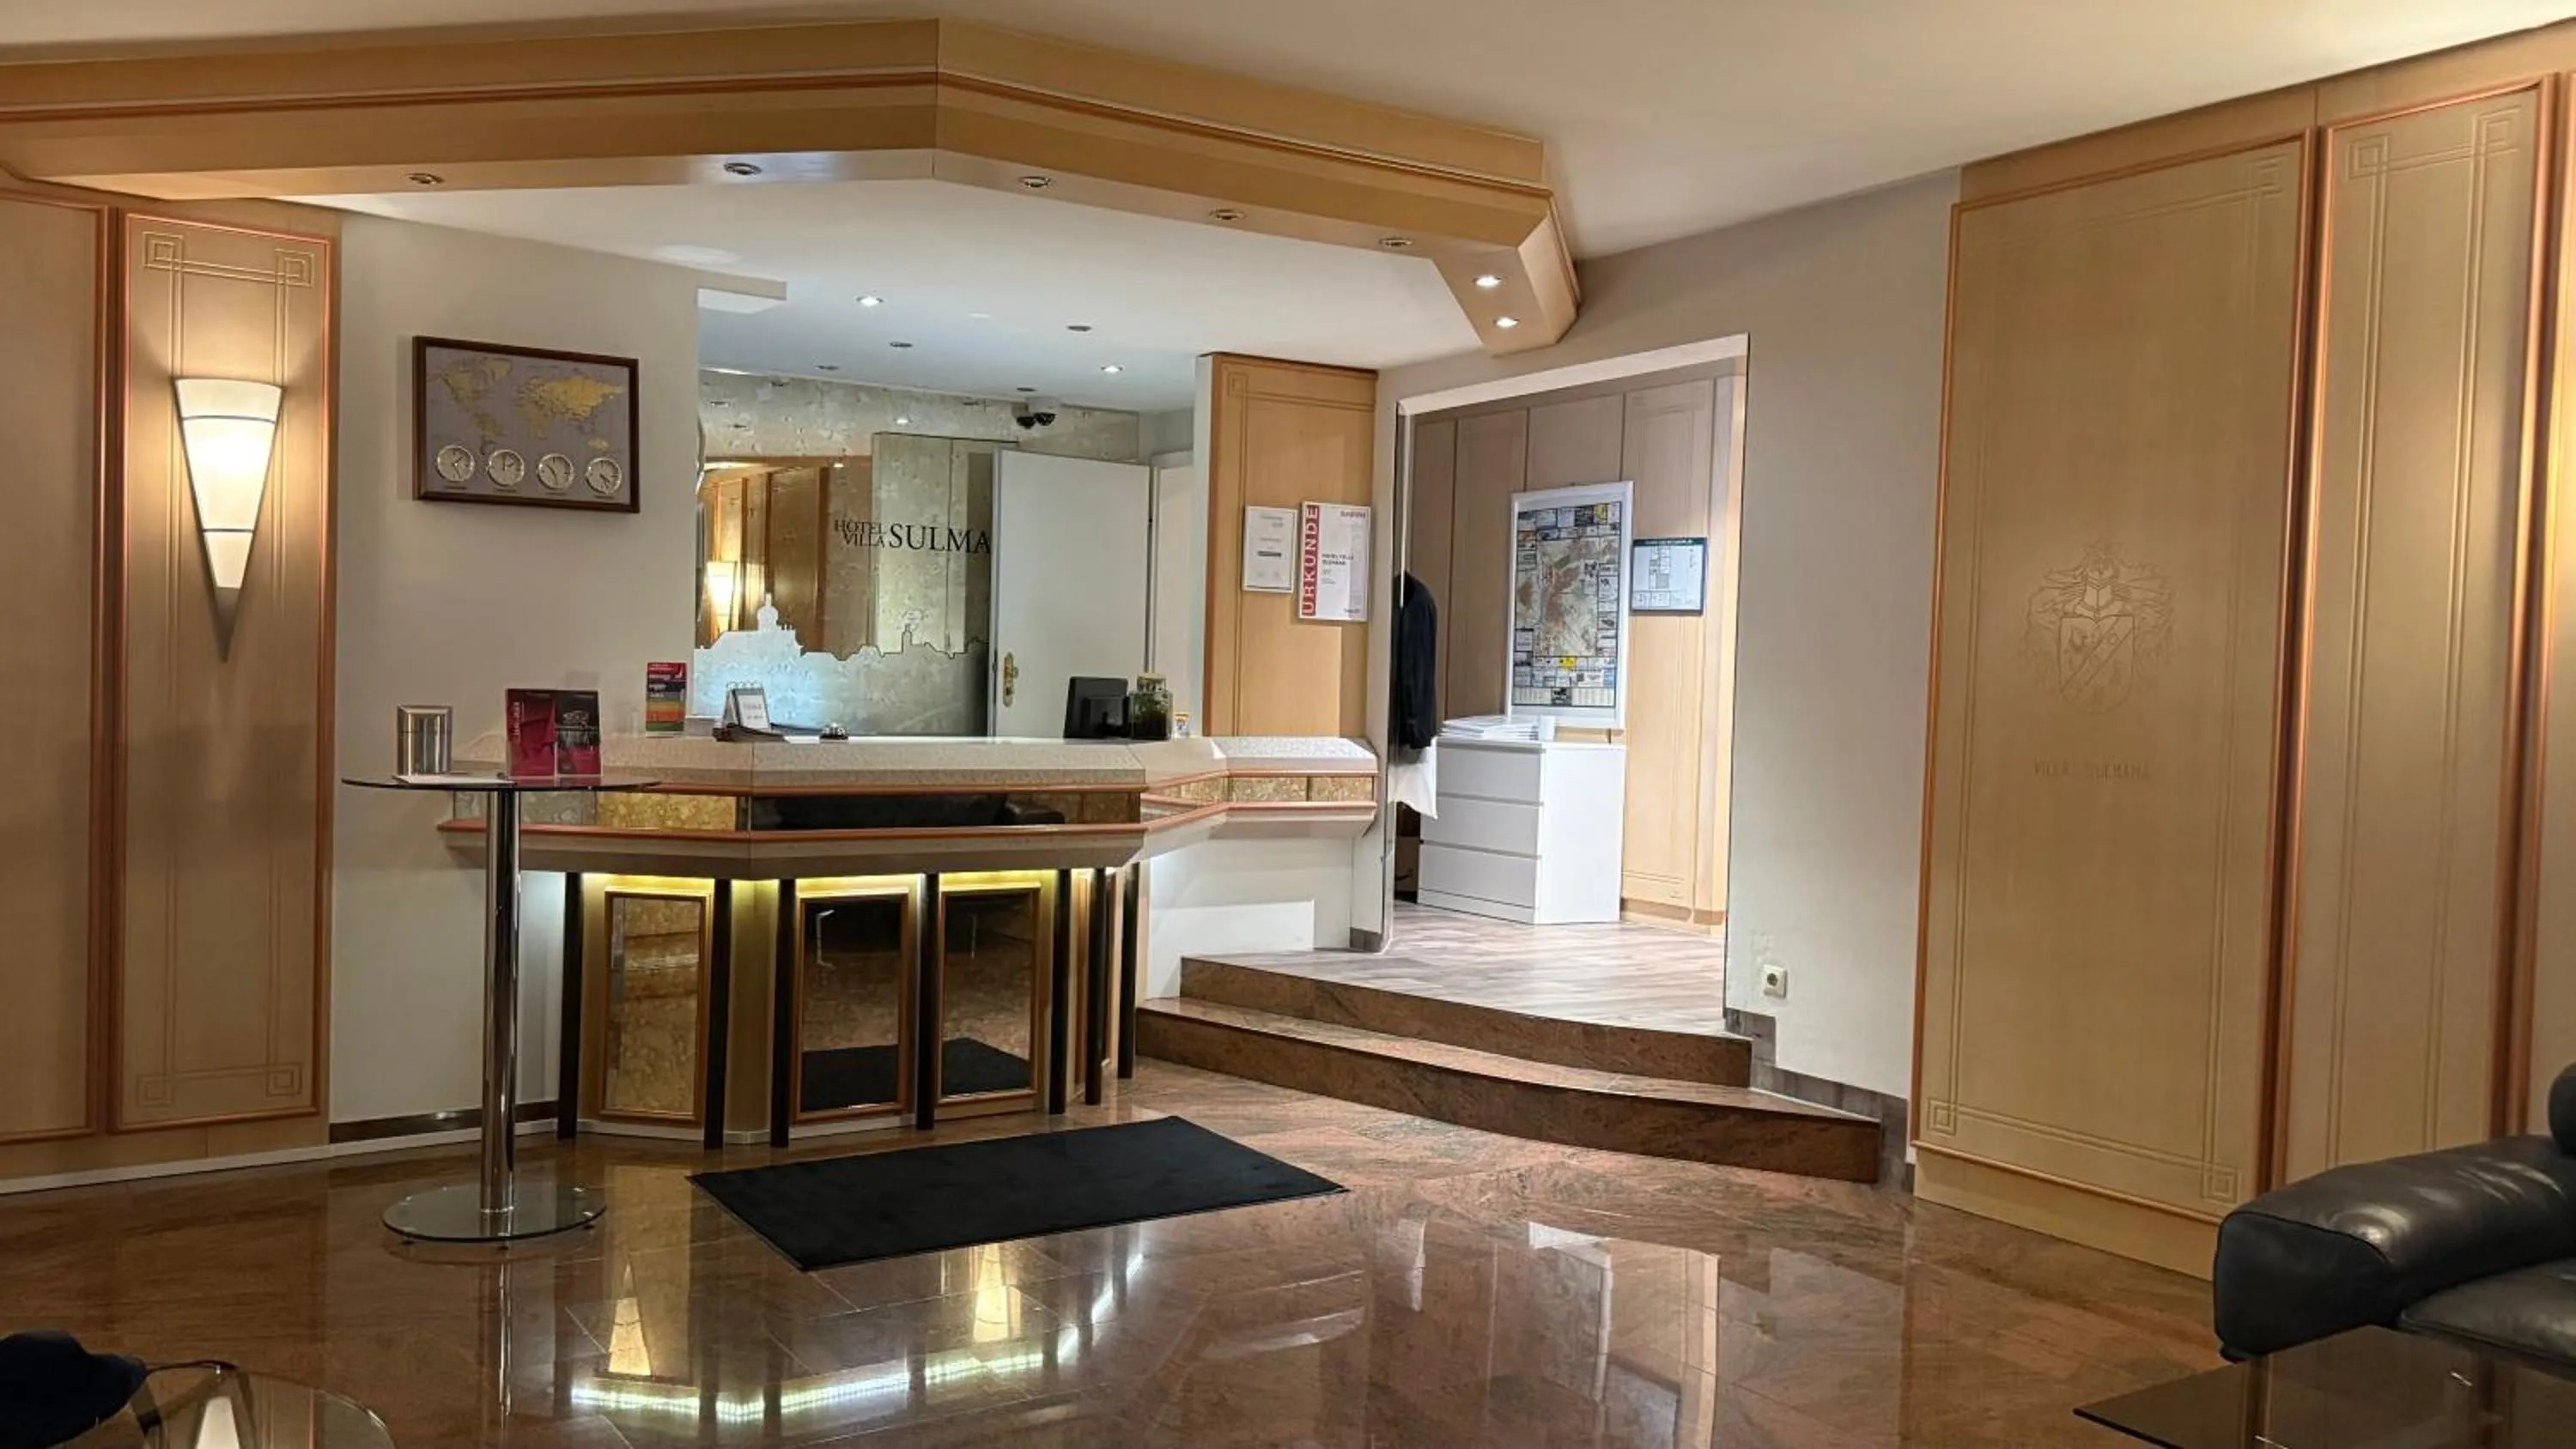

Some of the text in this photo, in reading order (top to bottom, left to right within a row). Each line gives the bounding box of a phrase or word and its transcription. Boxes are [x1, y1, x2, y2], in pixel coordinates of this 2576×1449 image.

[835, 519, 884, 533] HOTEL
[842, 523, 991, 553] VILLA SULMA
[1303, 506, 1318, 615] URKUNDE
